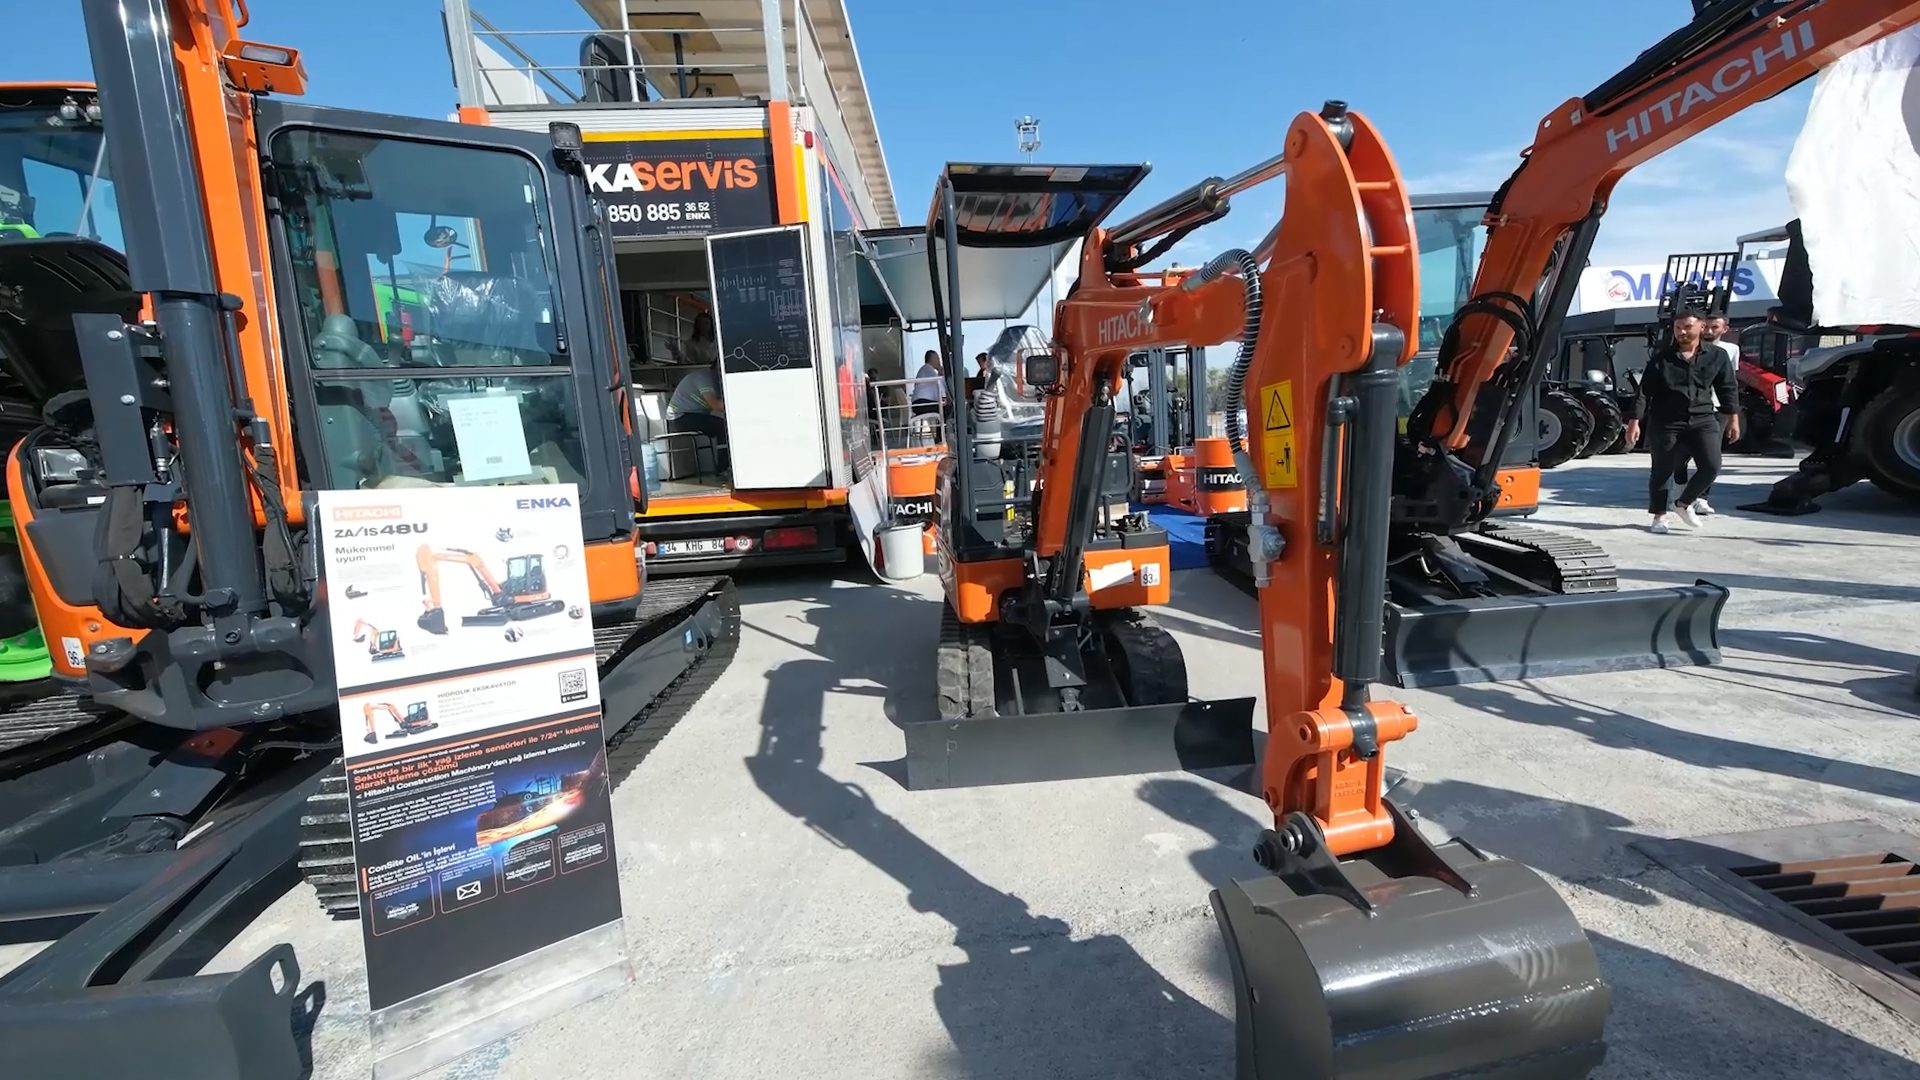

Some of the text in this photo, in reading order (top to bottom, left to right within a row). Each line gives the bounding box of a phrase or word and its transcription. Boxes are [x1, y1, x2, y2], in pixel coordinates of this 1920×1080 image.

[1606, 20, 1817, 153] HITACHI
[585, 159, 758, 193] KAservis
[608, 204, 642, 222] 850
[647, 203, 681, 221] 885
[684, 202, 696, 212] 36
[698, 202, 710, 212] 52
[685, 212, 711, 220] ENKA
[1203, 473, 1243, 484] HITAC
[516, 497, 572, 510] ENKA
[888, 501, 933, 515] TACHI
[335, 507, 401, 519] HITACHI
[666, 541, 676, 552] 34
[685, 540, 703, 551] KHG
[335, 555, 366, 564] uyum
[354, 768, 399, 784] Sektörde
[401, 765, 415, 773] bir
[434, 756, 452, 766] yağ
[454, 749, 483, 760] izleme
[485, 739, 527, 753] sensörleri
[528, 736, 539, 744] ile
[565, 722, 599, 735] kesintisiz
[354, 762, 459, 791] olarak izleme çözümü
[363, 786, 396, 798] Hitachi
[396, 773, 450, 790] Construction
[508, 755, 523, 765] yağ
[523, 750, 547, 760] izleme
[547, 741, 580, 754] sensörleri
[368, 860, 404, 875] ConSite
